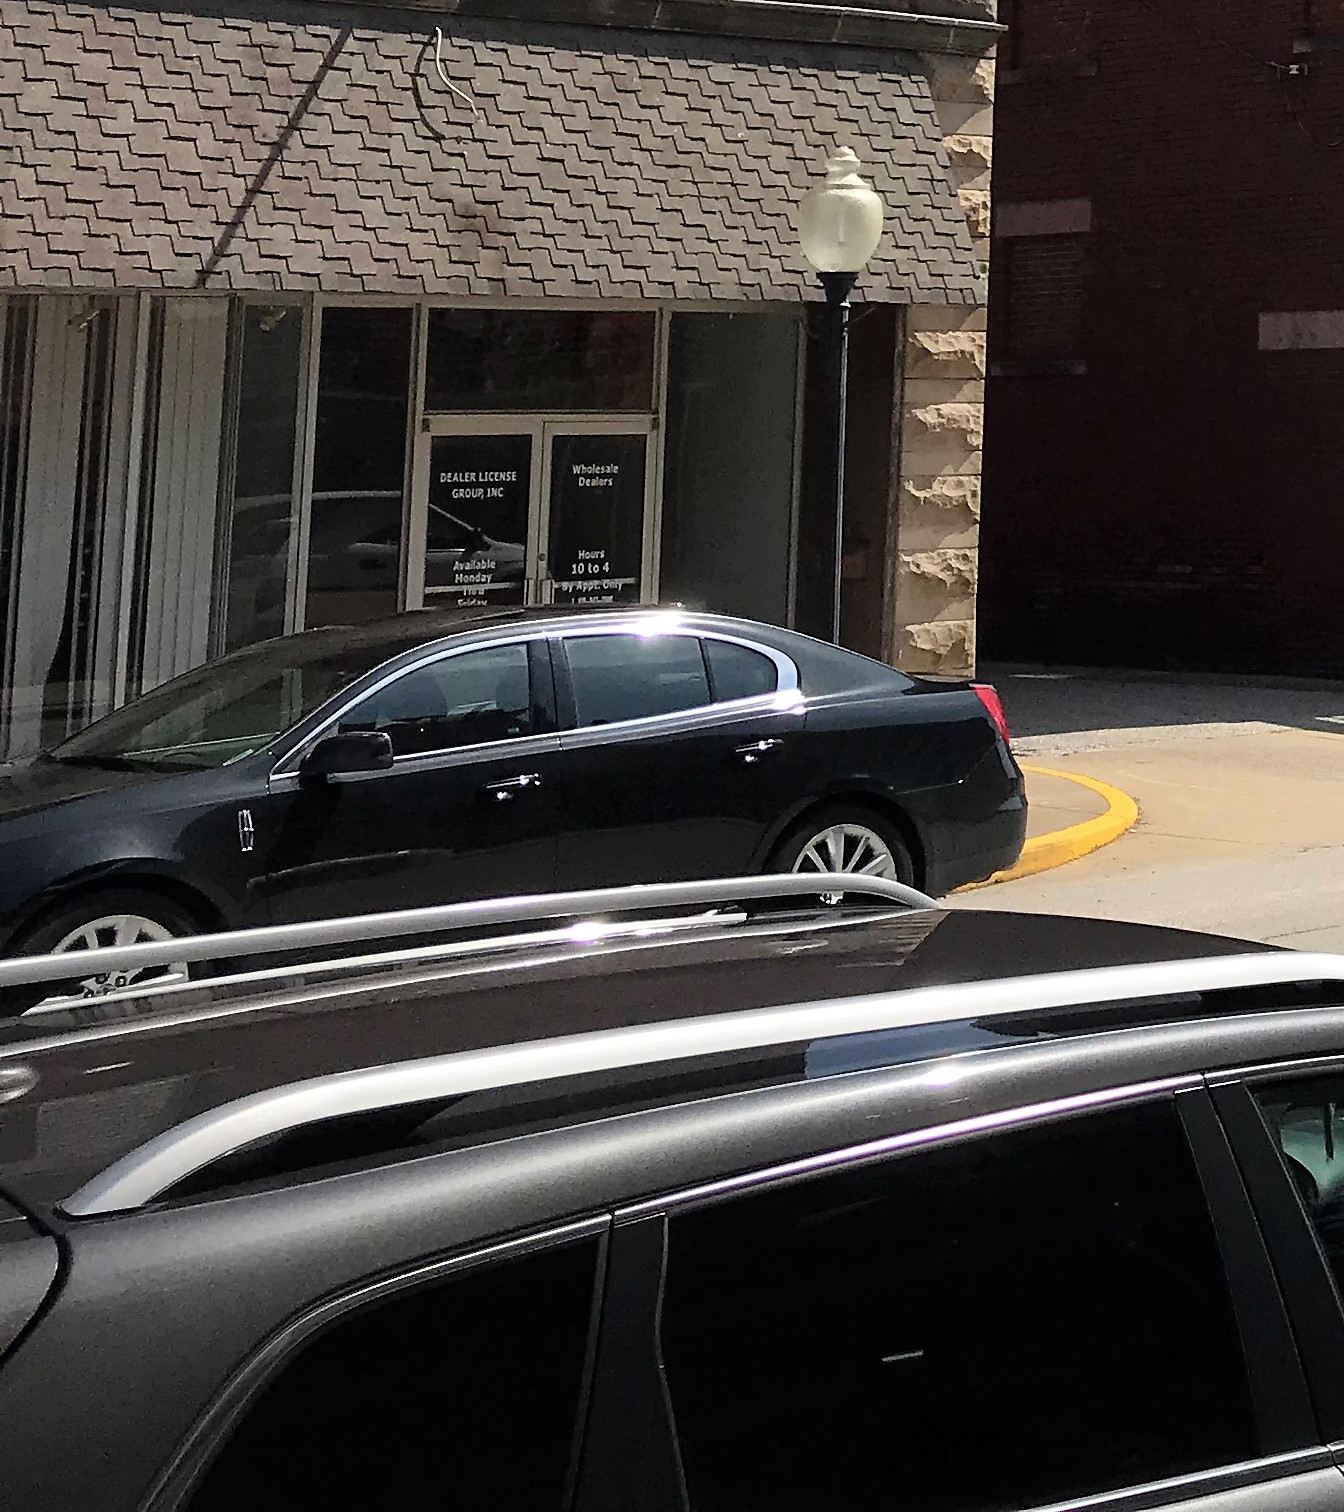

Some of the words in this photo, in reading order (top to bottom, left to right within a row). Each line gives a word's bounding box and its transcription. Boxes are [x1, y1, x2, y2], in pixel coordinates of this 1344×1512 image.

[572, 464, 619, 475] Wholesale
[440, 472, 477, 483] DEALER
[479, 471, 517, 482] LICENSE
[578, 476, 613, 487] Dealers
[452, 488, 485, 500] GROUP,
[486, 487, 504, 498] INC
[578, 549, 605, 560] Hours
[453, 559, 496, 571] Available
[571, 562, 585, 575] 10
[588, 562, 600, 574] to
[602, 561, 610, 573] 4
[455, 573, 494, 584] Monday
